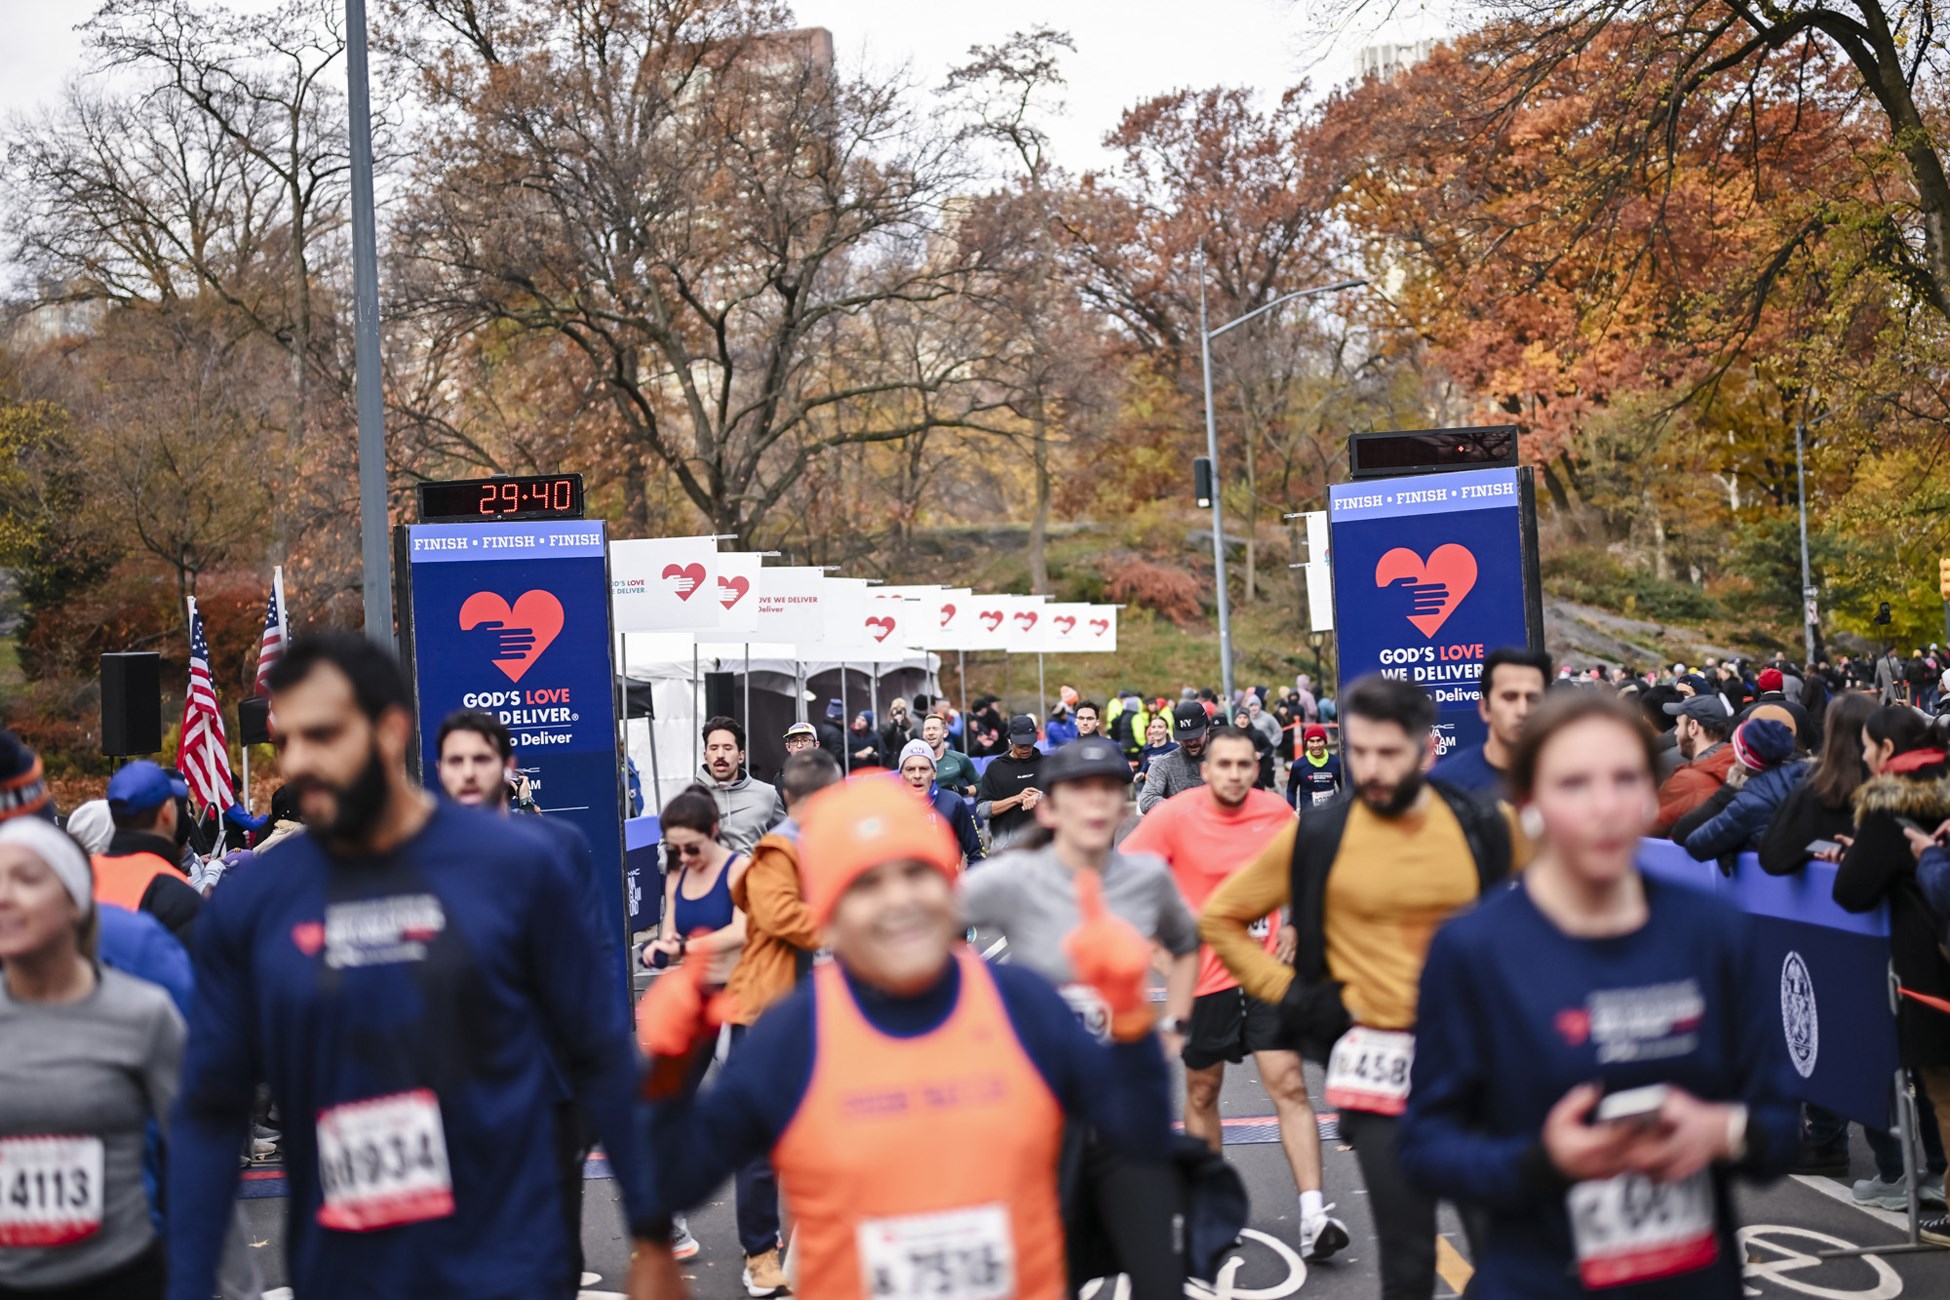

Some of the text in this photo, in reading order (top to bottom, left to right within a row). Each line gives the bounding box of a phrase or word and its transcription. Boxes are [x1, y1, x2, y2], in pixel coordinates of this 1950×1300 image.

[1334, 482, 1514, 511] FINISH FINISH FINISH
[413, 533, 601, 551] FINISH FINISH FINISH
[1379, 643, 1484, 664] GOD'S LOVE
[463, 688, 571, 708] GOD'S LOVE
[1435, 687, 1483, 702] Delive
[1179, 718, 1192, 728] NY
[521, 731, 573, 746] Deliver
